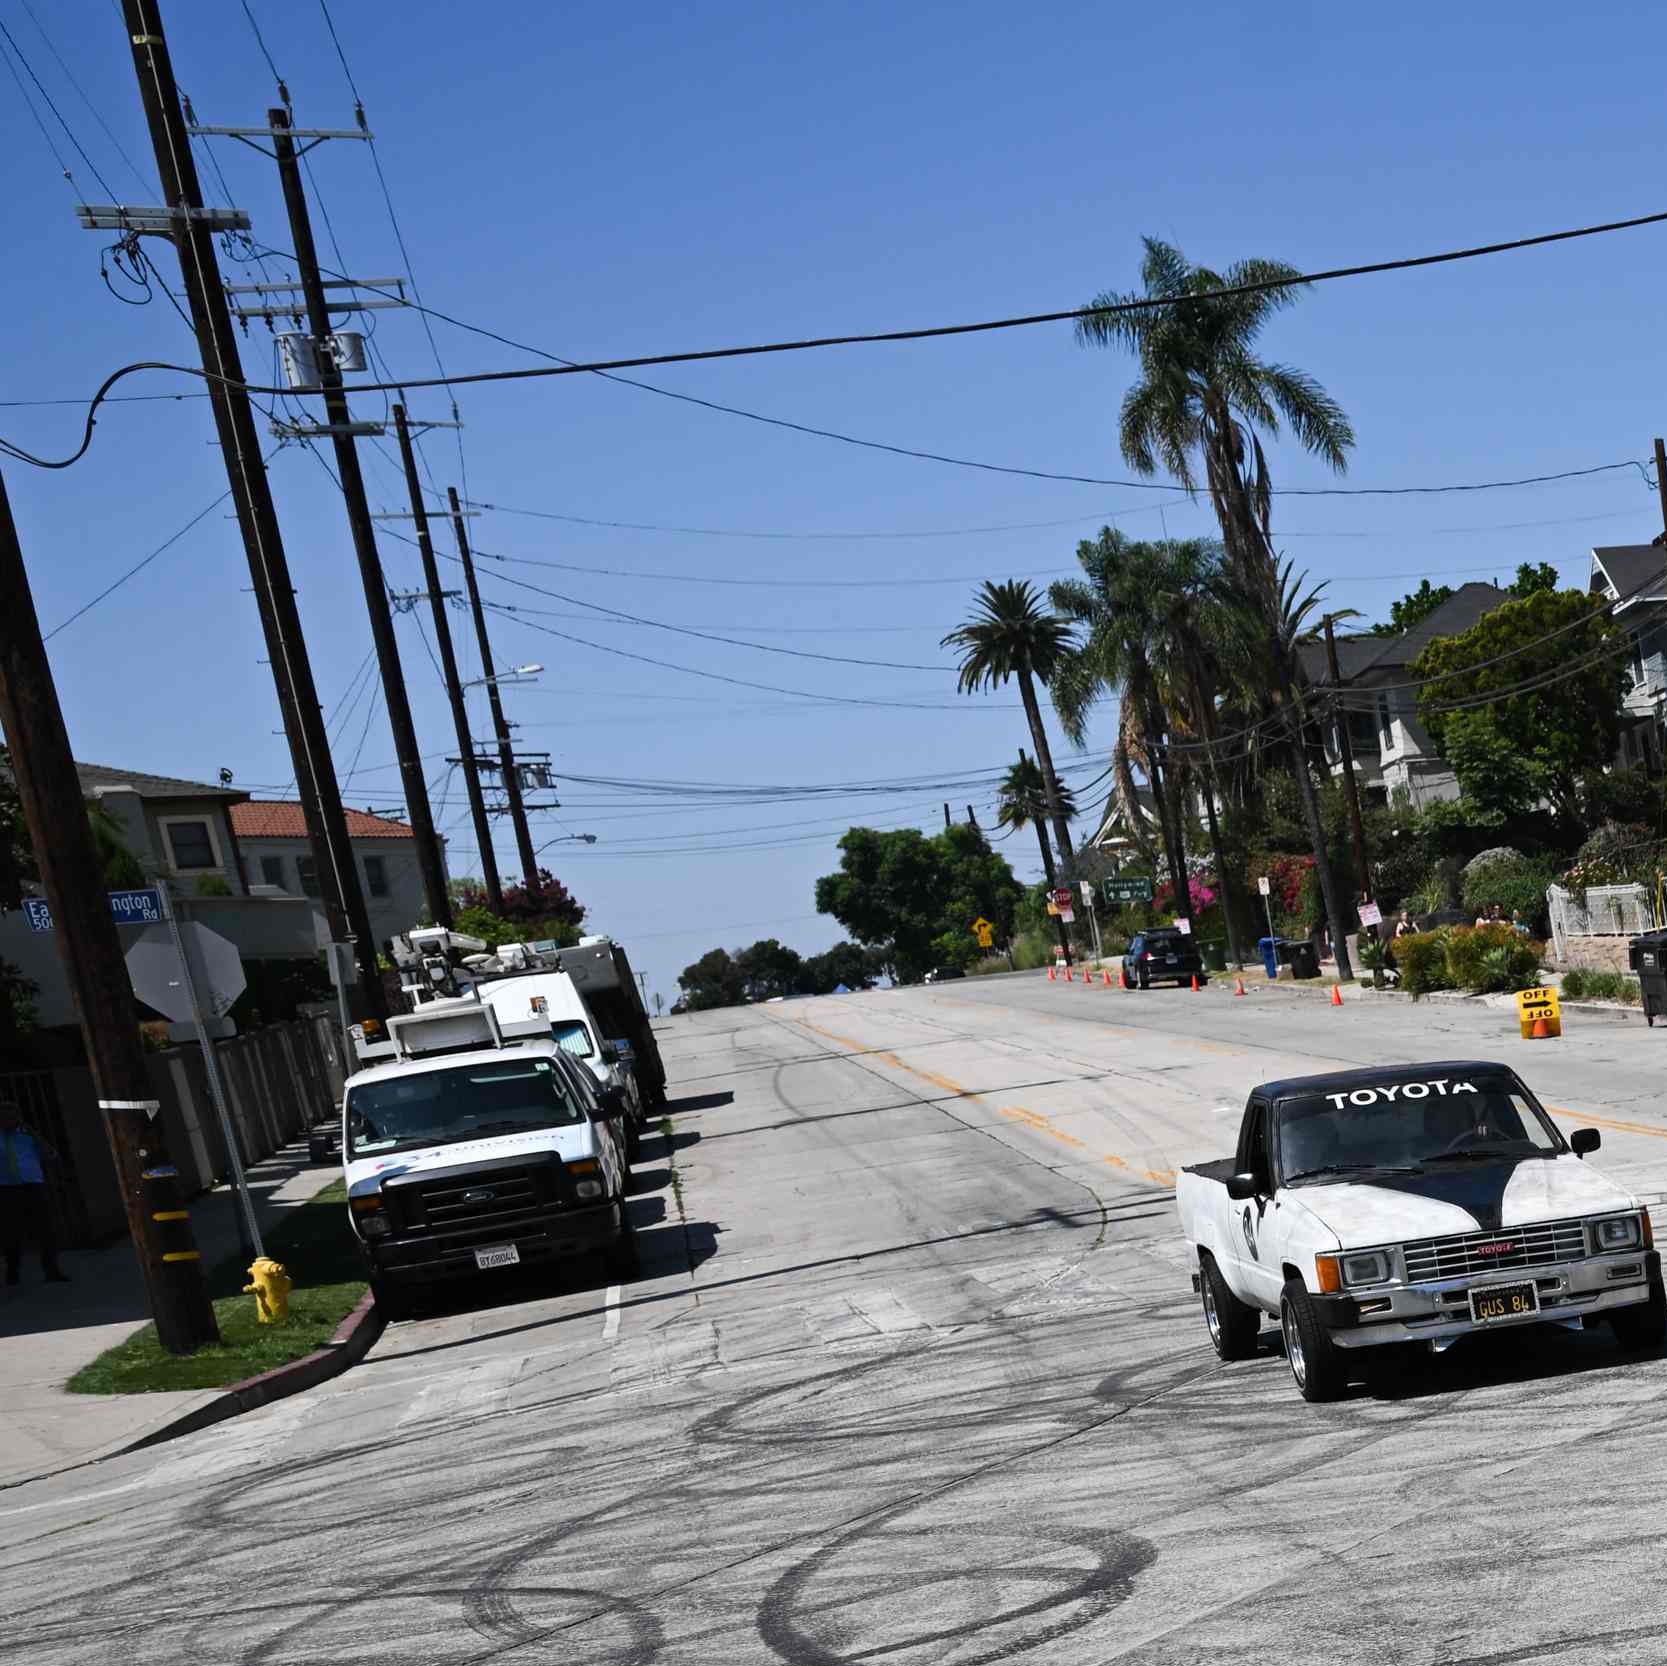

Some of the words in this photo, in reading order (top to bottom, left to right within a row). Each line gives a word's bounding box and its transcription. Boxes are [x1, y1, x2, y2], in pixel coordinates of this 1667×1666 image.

[29, 902, 49, 918] Ea
[112, 895, 151, 914] ngton
[143, 909, 158, 920] Rd
[1523, 990, 1550, 999] OFF
[1326, 1078, 1478, 1110] TOYOTA
[1480, 1299, 1505, 1319] GUS
